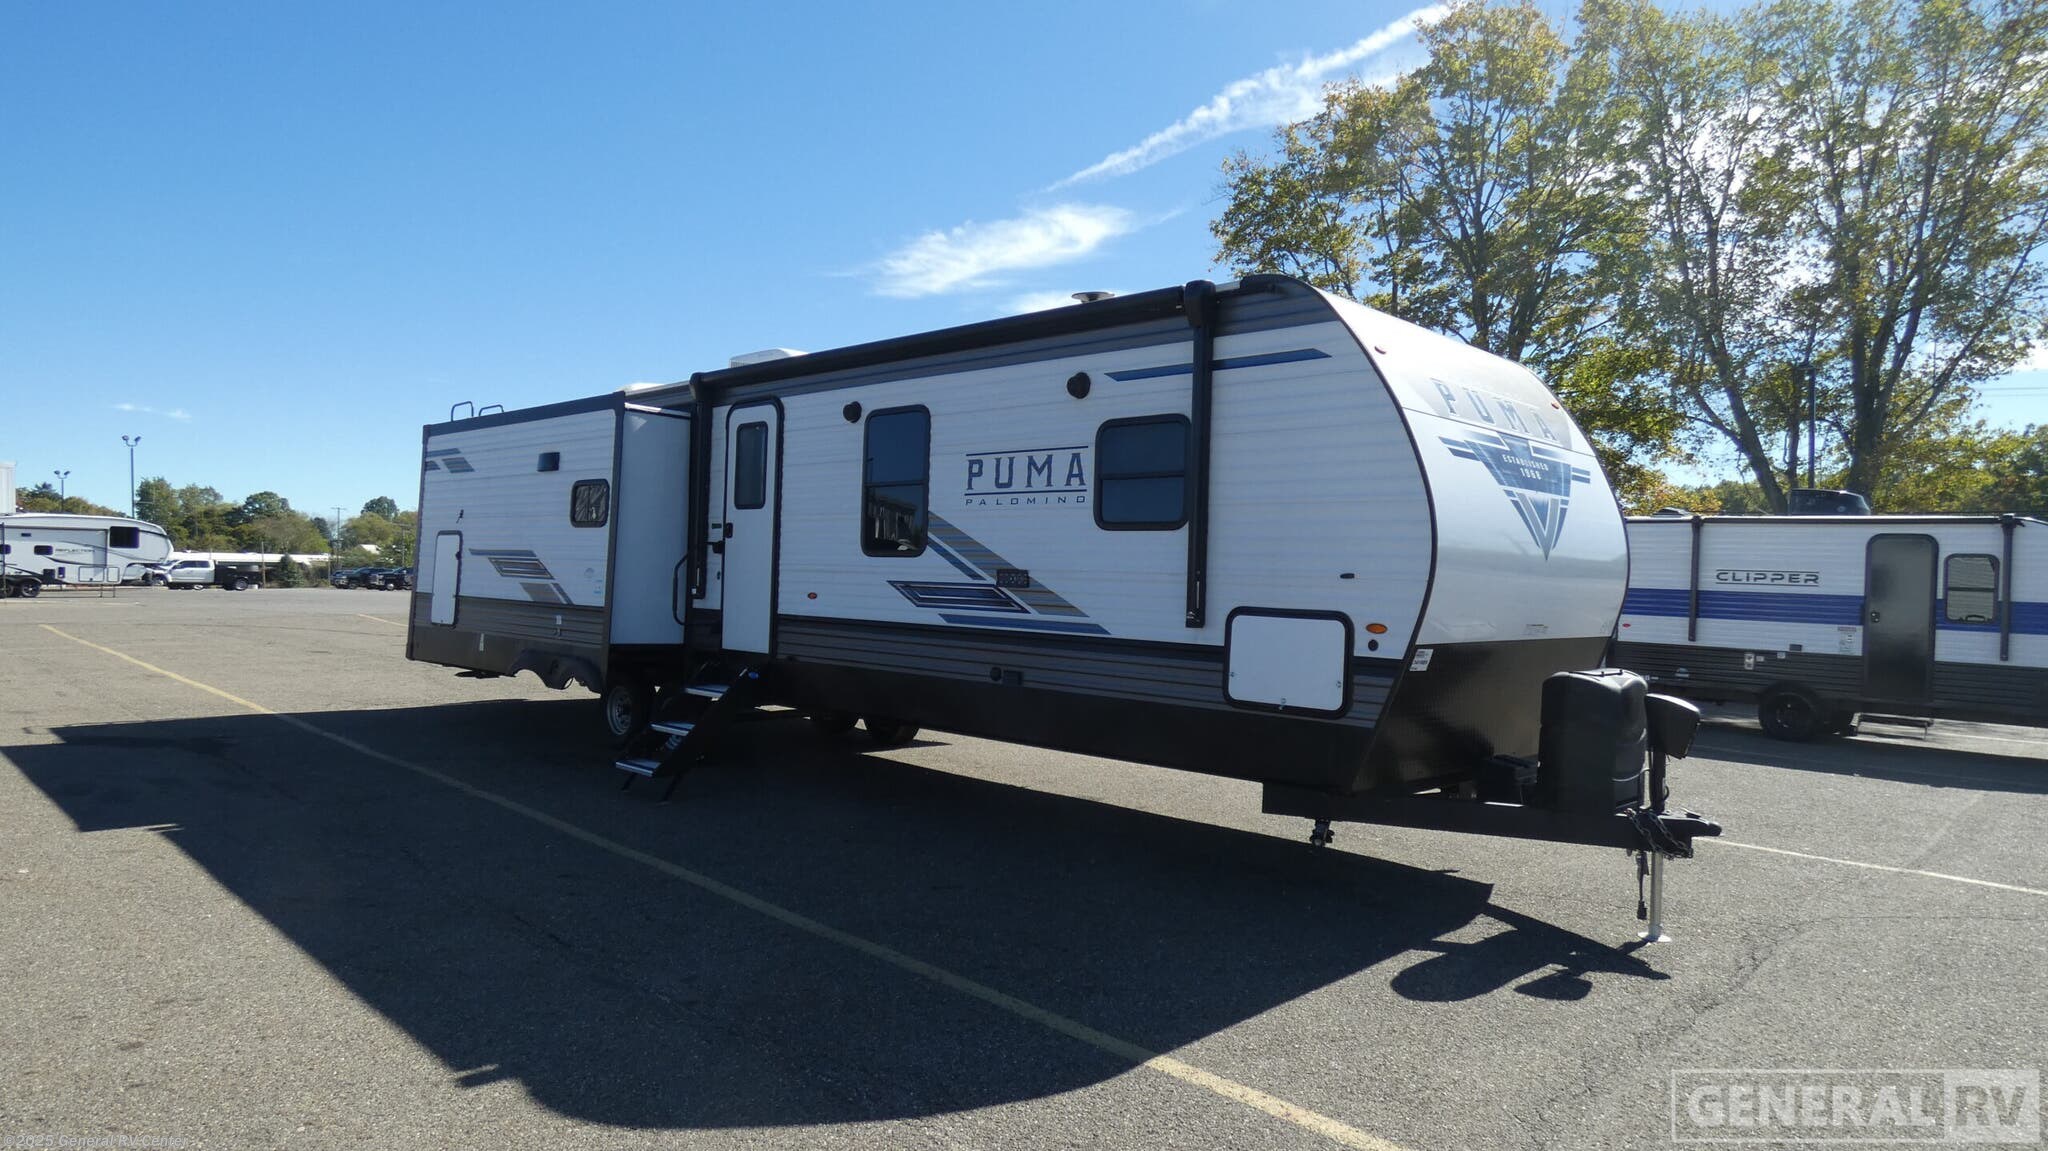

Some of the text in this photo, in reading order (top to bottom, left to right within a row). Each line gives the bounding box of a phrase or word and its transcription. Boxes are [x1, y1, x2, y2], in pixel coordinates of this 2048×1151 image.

[1432, 380, 1560, 443] PUMA
[1502, 454, 1549, 471] ESTABLISHED
[967, 453, 1086, 490] PUMA
[965, 495, 1086, 506] PALOMINO
[1716, 571, 1819, 584] CLIPPER
